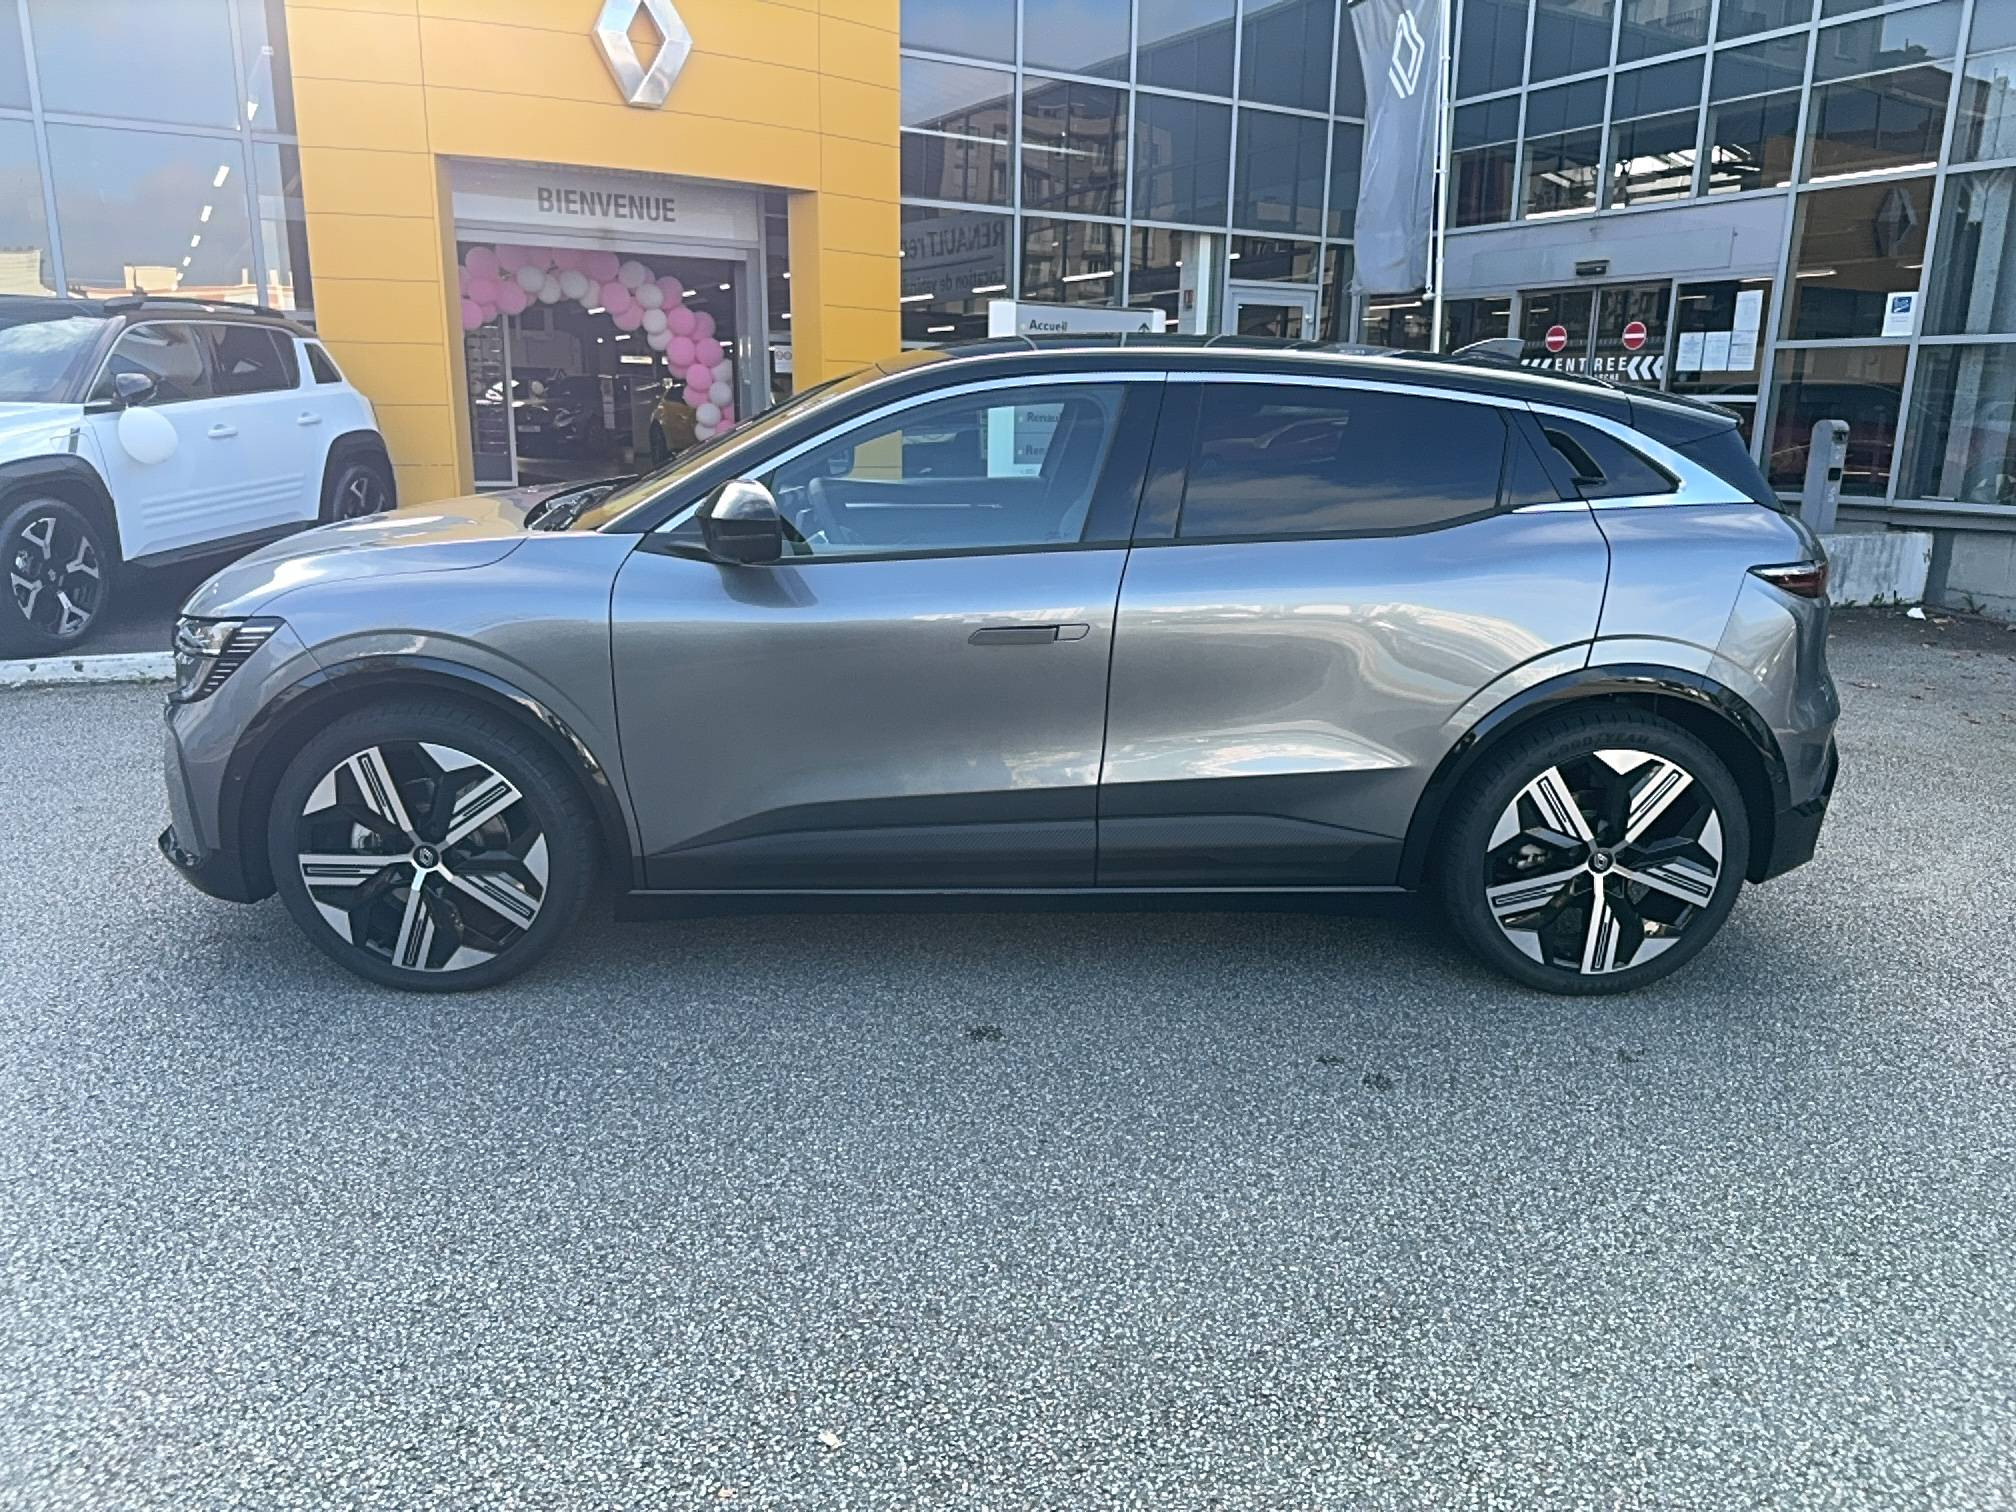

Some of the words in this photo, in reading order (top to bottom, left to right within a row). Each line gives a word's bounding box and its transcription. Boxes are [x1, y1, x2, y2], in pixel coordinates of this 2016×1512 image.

[537, 186, 676, 223] BIENVENUE
[1029, 319, 1068, 332] Accueil
[1554, 356, 1629, 372] ENTREE
